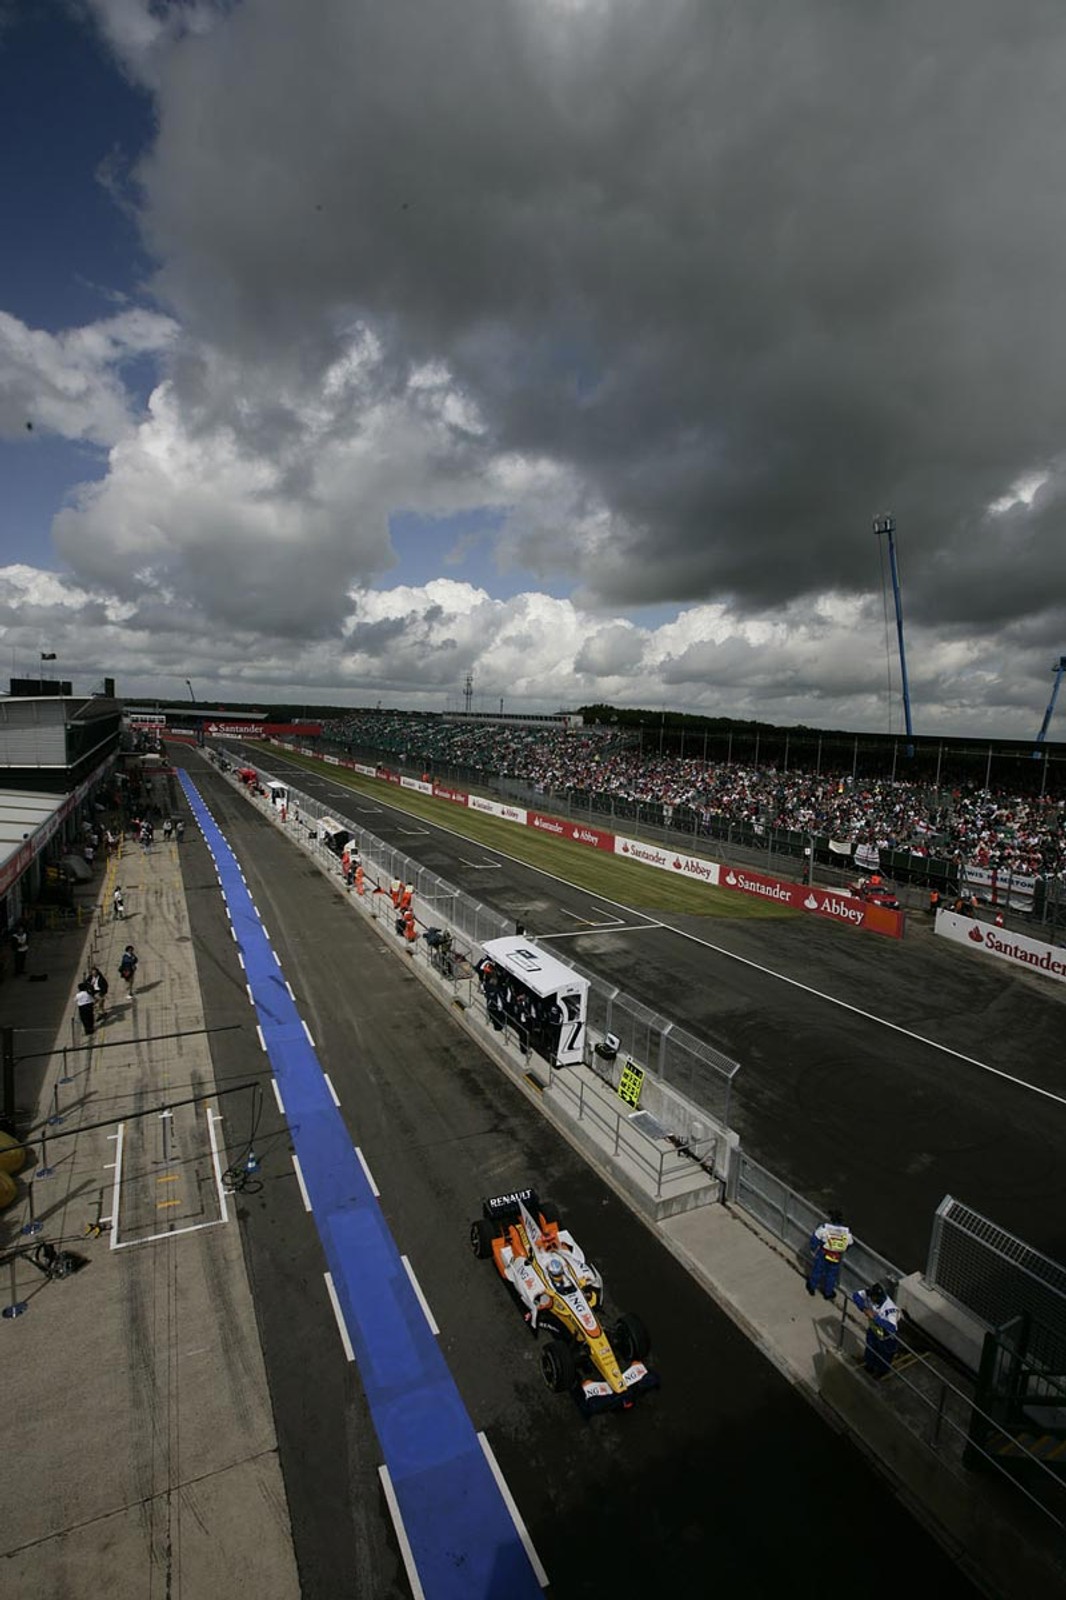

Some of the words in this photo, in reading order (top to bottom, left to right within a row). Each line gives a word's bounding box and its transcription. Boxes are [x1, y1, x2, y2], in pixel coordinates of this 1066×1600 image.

[219, 723, 263, 735] Santander
[539, 817, 564, 834] Santander
[579, 829, 599, 847] Abbey
[630, 844, 667, 867] Santander
[683, 859, 712, 880] Abbey
[738, 875, 792, 902] Santander
[820, 898, 865, 926] Abbey
[985, 931, 1066, 978] Santander
[490, 1189, 532, 1208] RENAULT
[568, 1293, 586, 1313] ING
